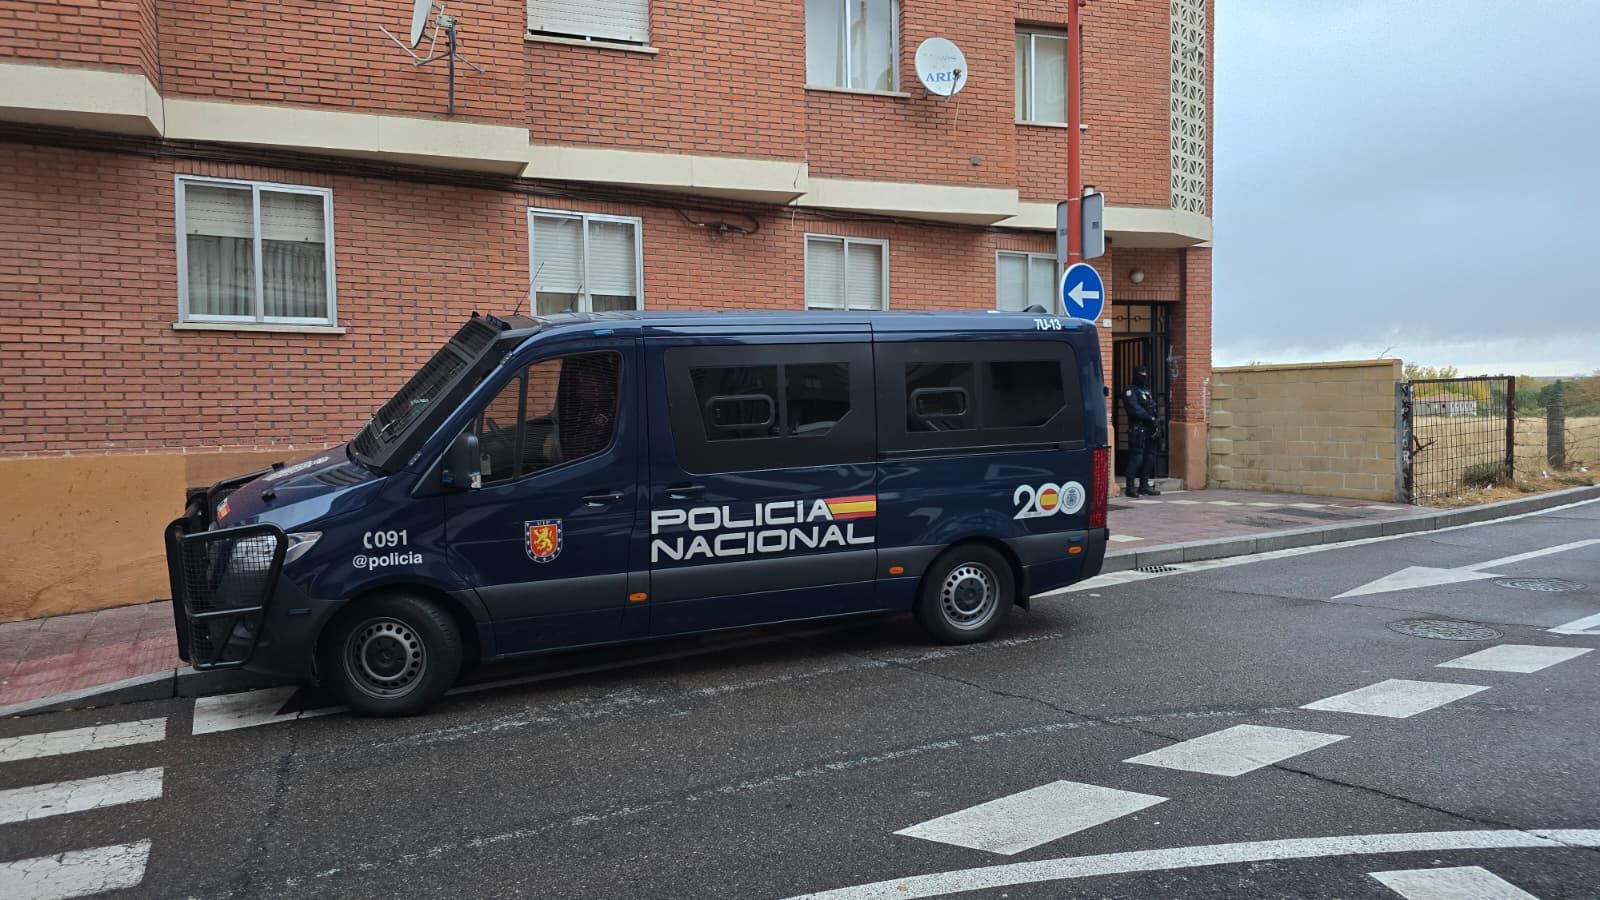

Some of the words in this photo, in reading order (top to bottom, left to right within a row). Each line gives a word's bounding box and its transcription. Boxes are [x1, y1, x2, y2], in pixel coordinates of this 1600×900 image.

[1033, 318, 1062, 331] 7U-13
[1013, 481, 1086, 520] 200
[651, 523, 876, 563] NACIONAL
[352, 551, 423, 571] @policia
